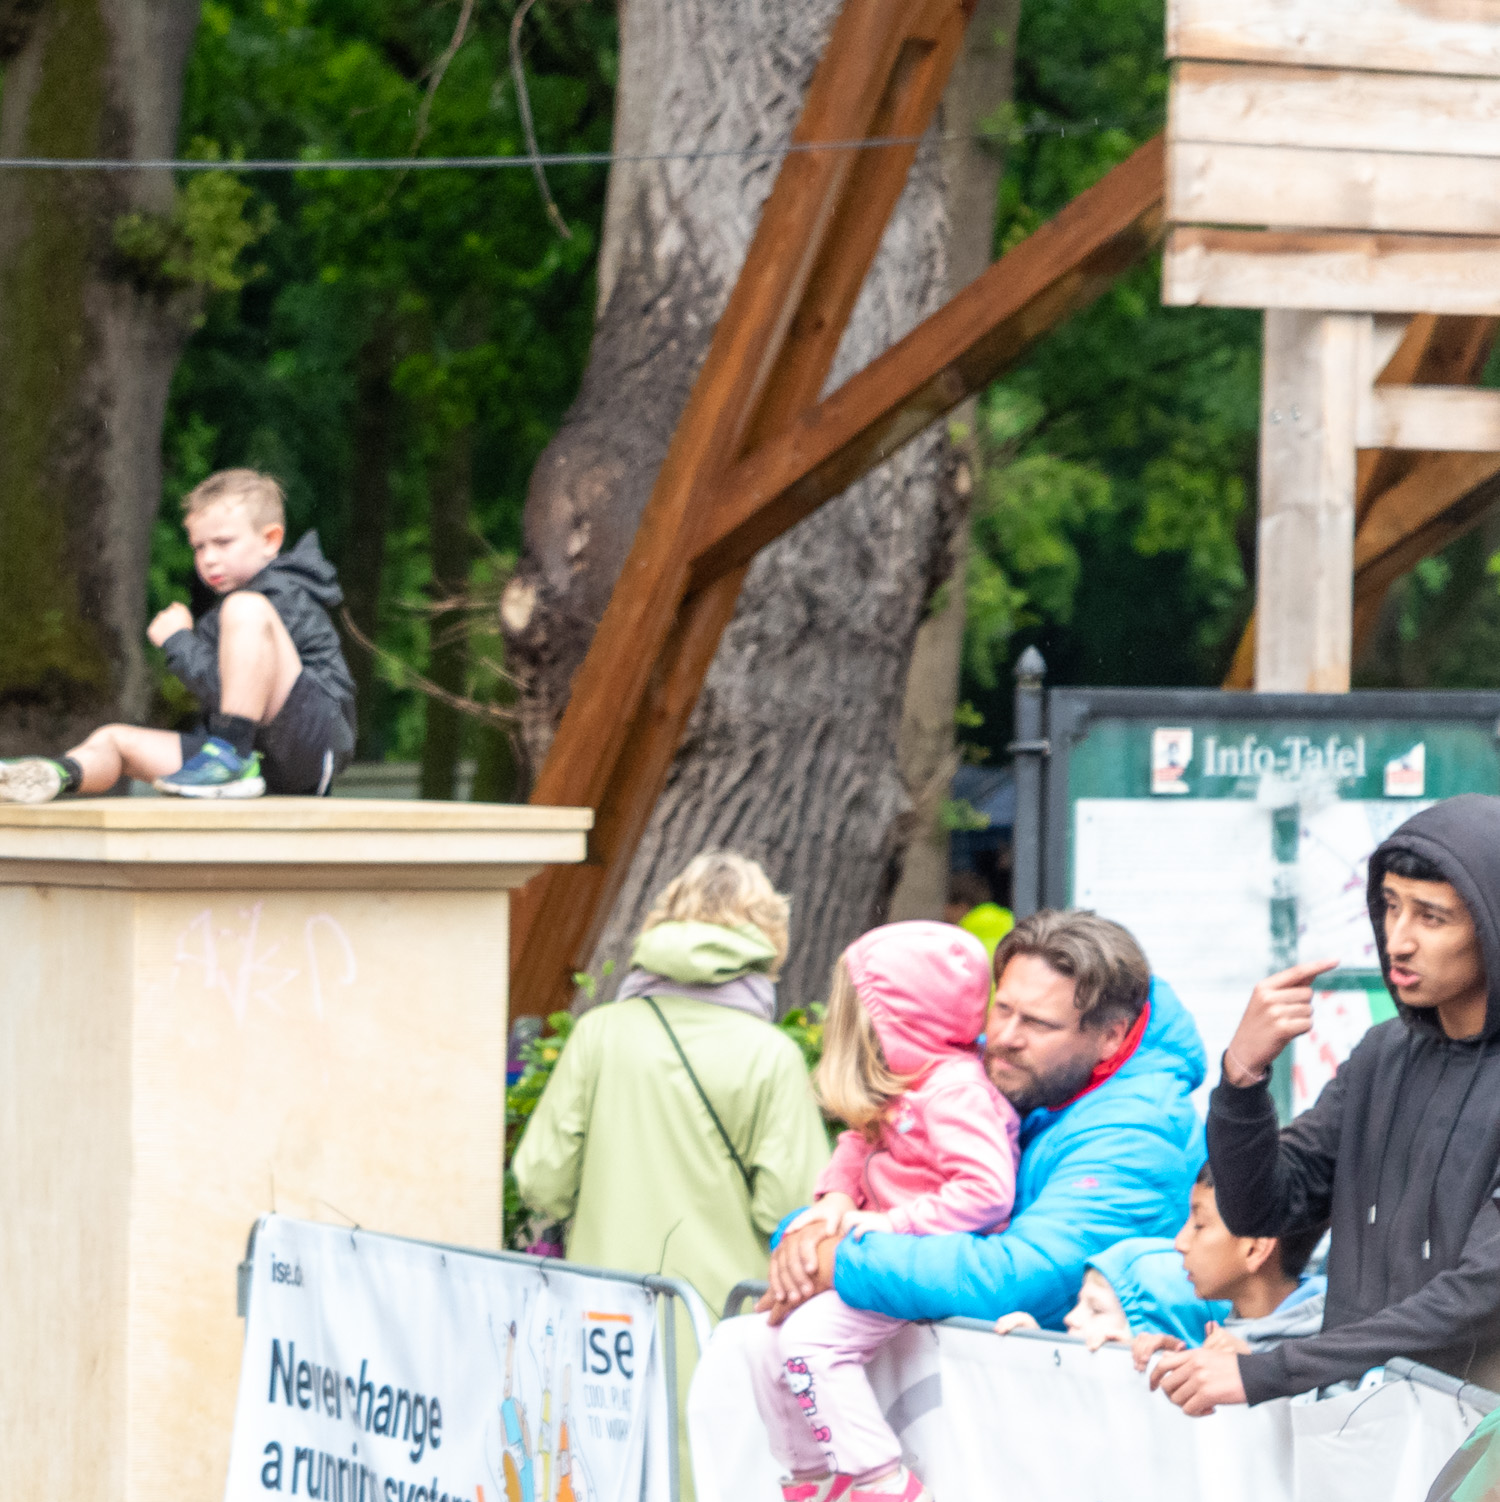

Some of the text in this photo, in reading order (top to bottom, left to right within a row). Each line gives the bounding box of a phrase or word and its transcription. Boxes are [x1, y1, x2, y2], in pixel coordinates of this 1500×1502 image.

[1203, 733, 1367, 777] Info-Tafel
[268, 1337, 443, 1465] Never change
[260, 1440, 283, 1491] a
